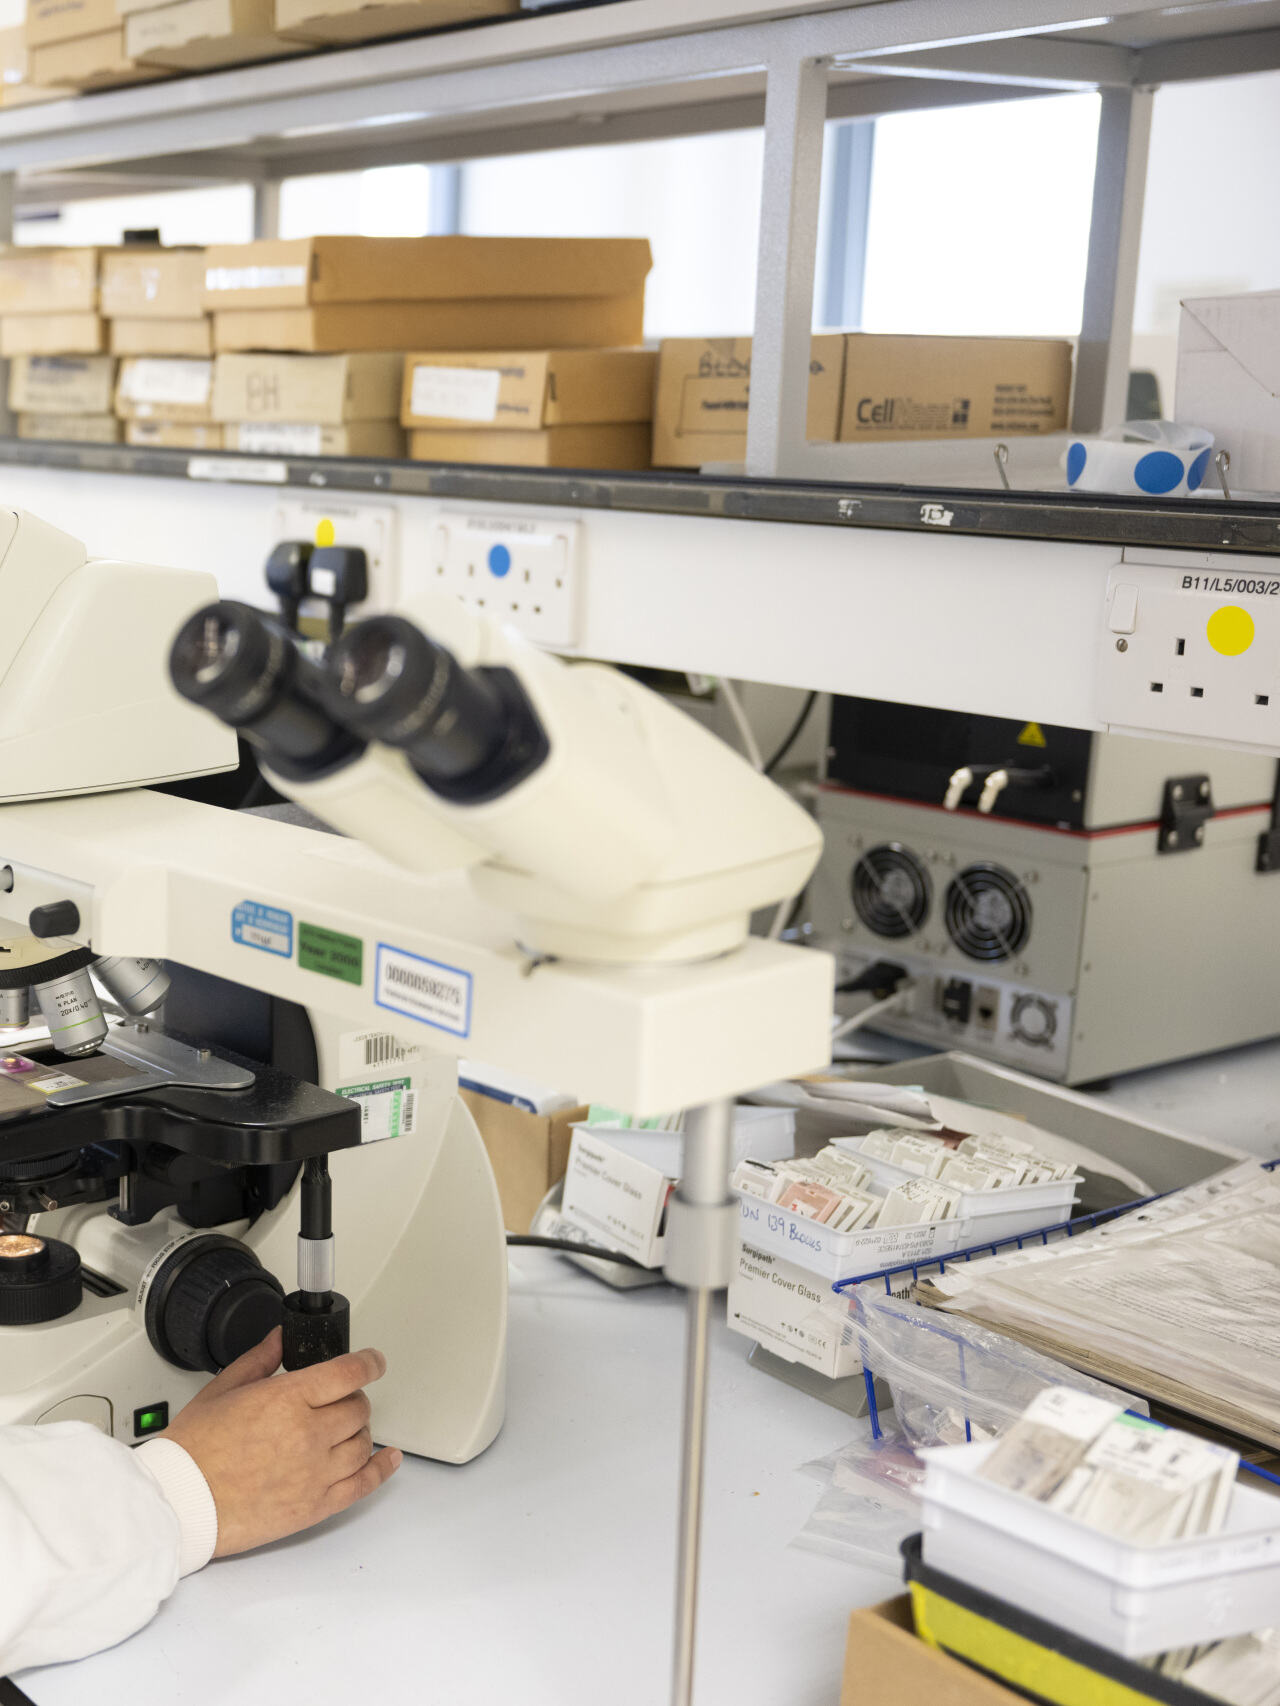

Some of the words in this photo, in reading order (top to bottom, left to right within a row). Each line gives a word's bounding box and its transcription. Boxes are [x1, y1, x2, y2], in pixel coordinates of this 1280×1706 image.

[740, 1257, 771, 1281] Premier
[771, 1272, 796, 1292] Cover
[797, 1284, 822, 1303] Glass
